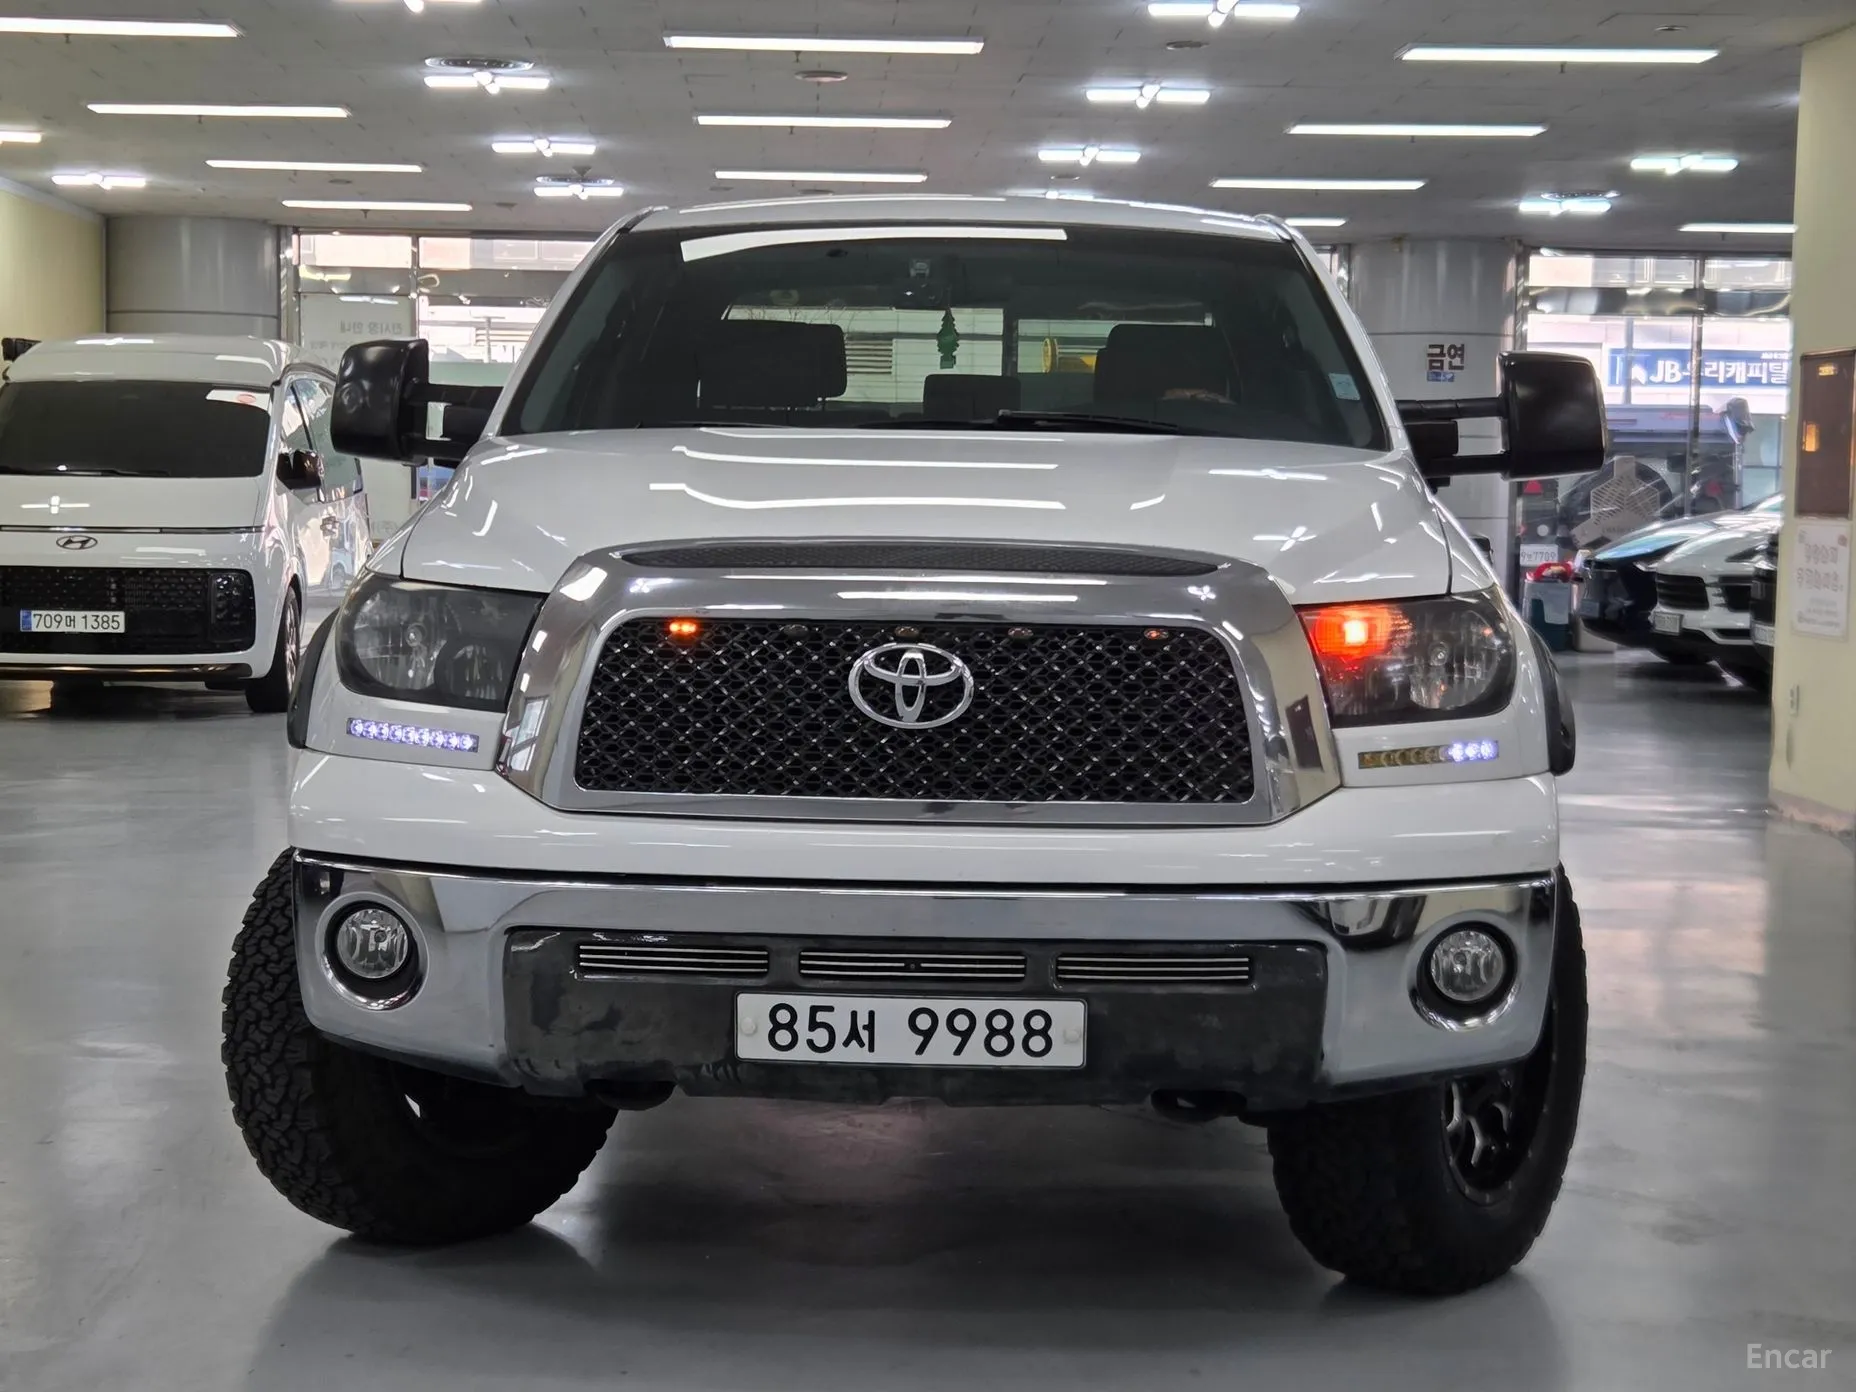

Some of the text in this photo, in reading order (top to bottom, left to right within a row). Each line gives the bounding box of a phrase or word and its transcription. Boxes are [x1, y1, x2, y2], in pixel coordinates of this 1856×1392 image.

[1427, 344, 1464, 371] 금연
[81, 614, 120, 630] 1385
[768, 1002, 1053, 1058] 85서 9988
